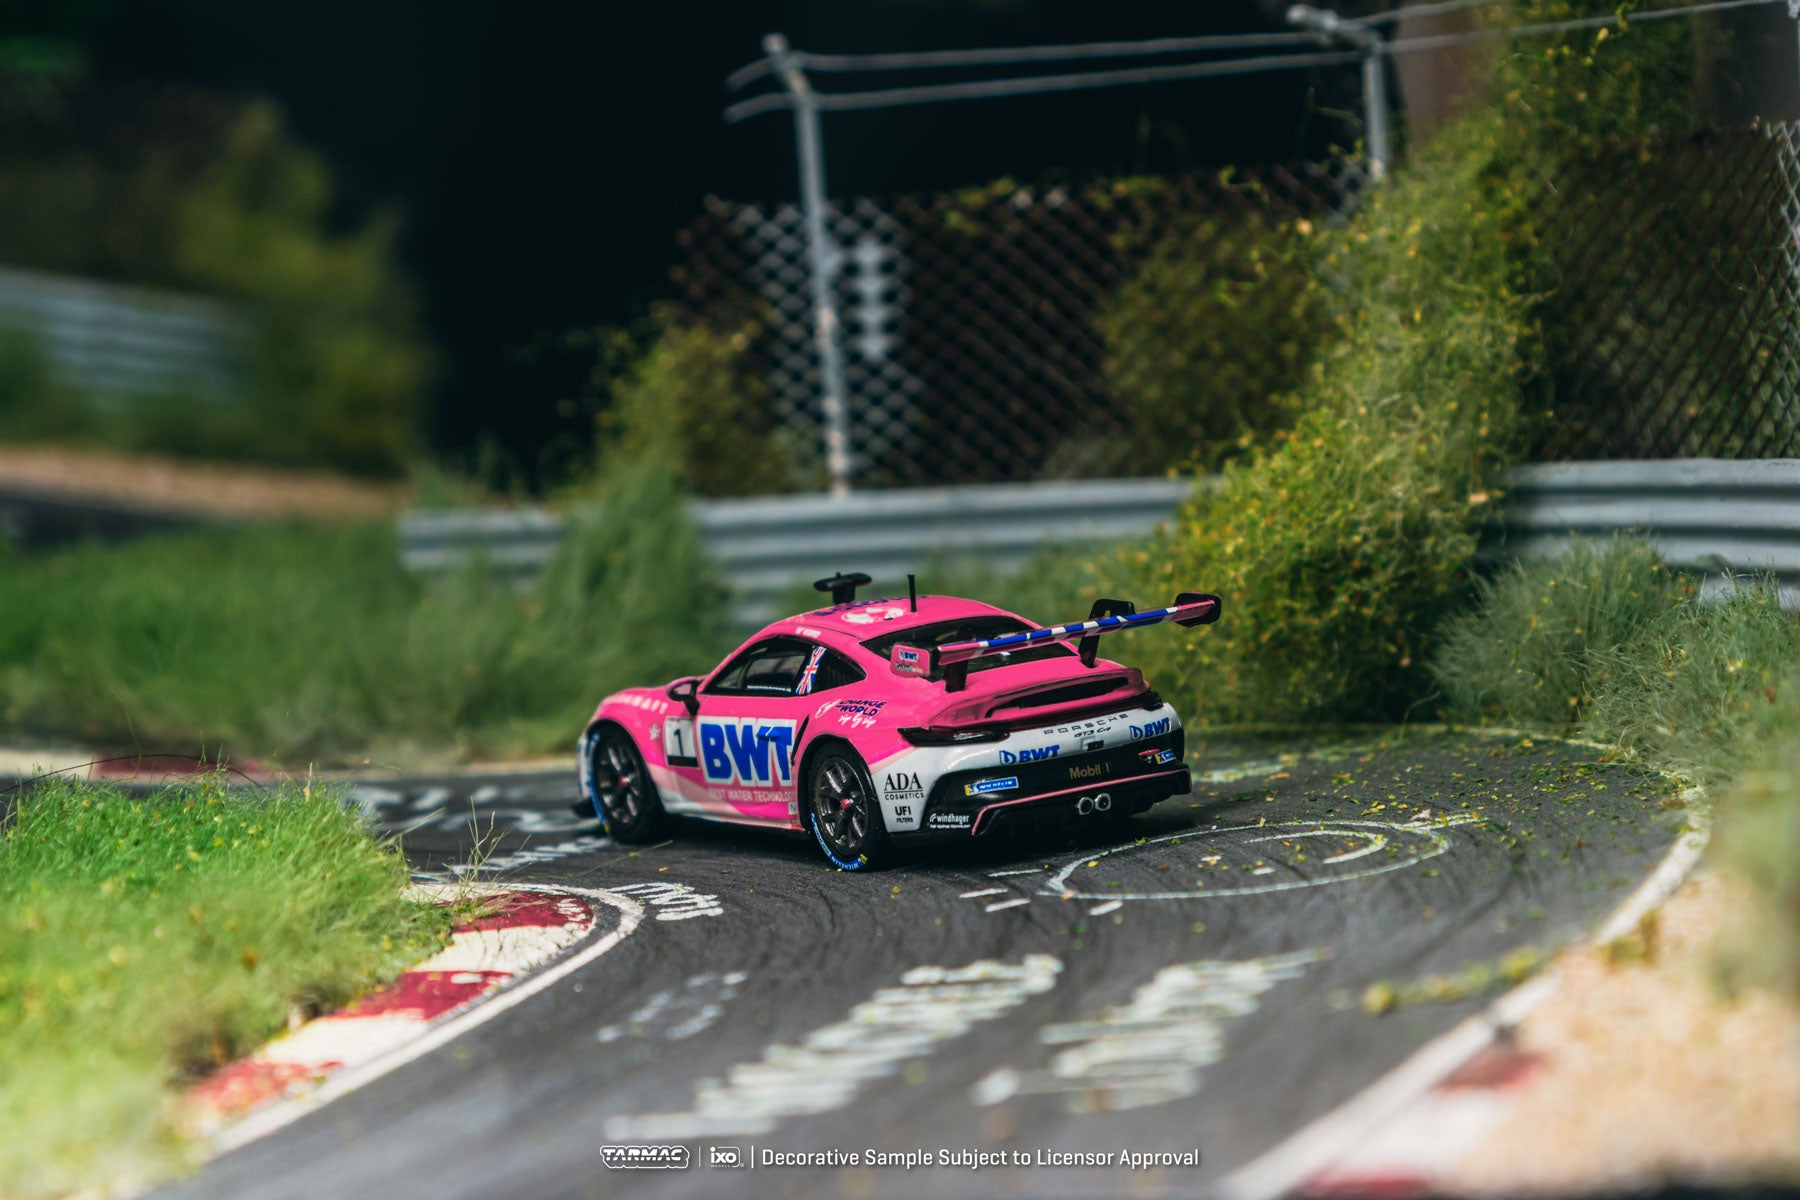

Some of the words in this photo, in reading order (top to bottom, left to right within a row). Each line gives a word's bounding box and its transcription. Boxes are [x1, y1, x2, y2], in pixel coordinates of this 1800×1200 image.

[839, 704, 878, 717] WORLD
[1043, 713, 1128, 735] PORSCHE
[1144, 717, 1170, 738] BWT
[1073, 729, 1095, 738] GT3
[674, 728, 684, 757] 1
[700, 723, 793, 781] BWT
[1019, 744, 1060, 764] BWT
[1069, 763, 1101, 779] Mobil
[884, 772, 923, 791] ADA
[727, 789, 753, 801] WATER
[884, 791, 925, 801] COSMETICS
[894, 805, 912, 816] UFI
[936, 813, 970, 825] windhager
